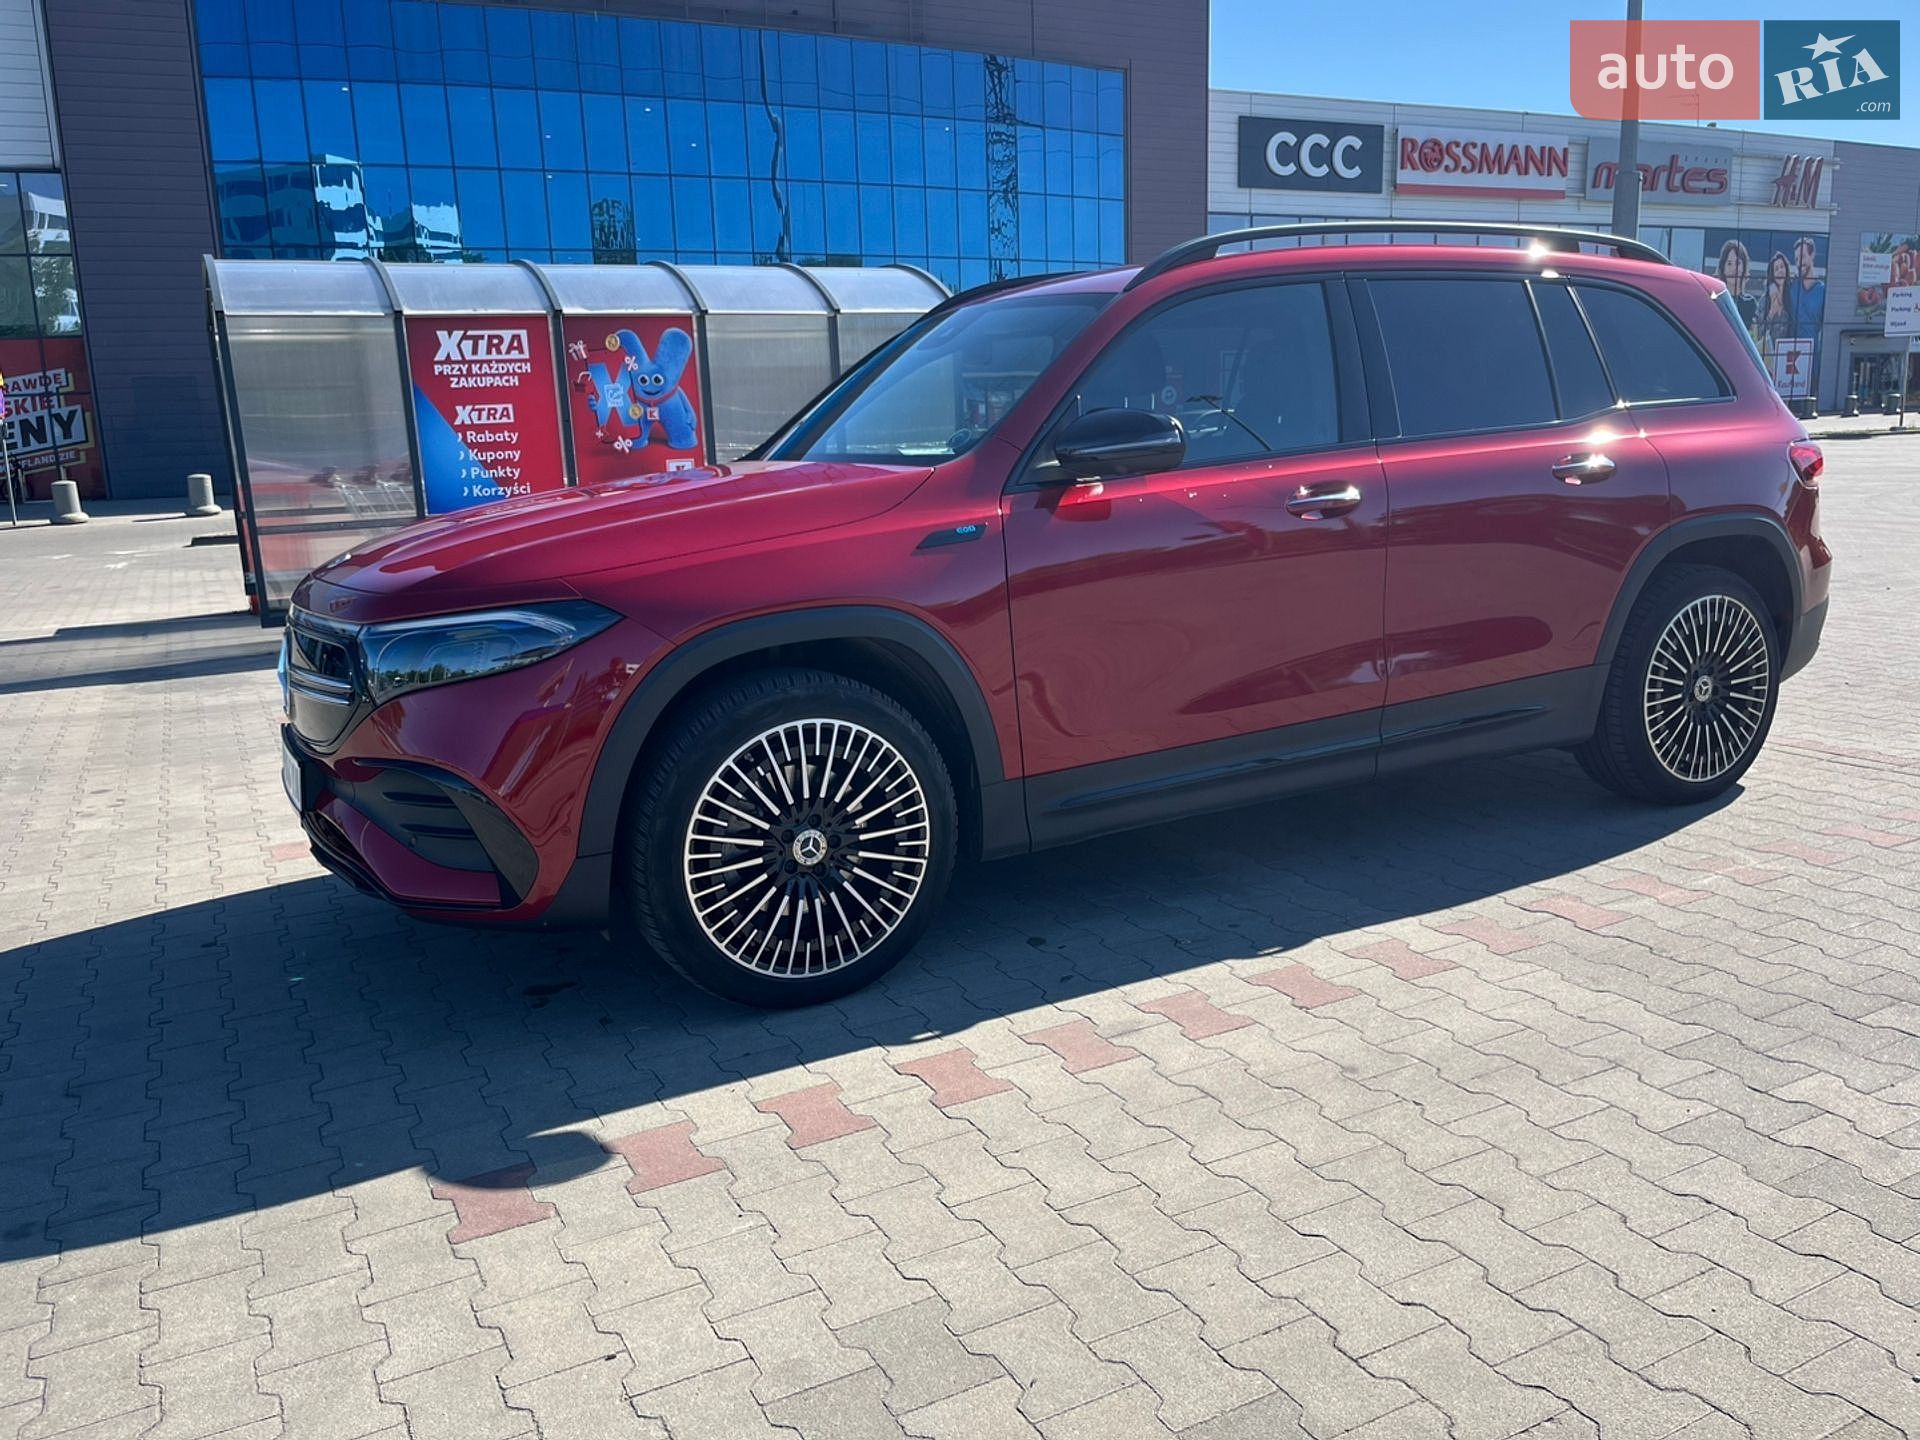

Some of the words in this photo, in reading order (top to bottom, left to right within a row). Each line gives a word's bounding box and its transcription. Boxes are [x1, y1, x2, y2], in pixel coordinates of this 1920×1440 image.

[1265, 131, 1363, 179] CCC
[1400, 137, 1569, 178] ROSSMANN
[1772, 153, 1824, 208] H&M
[433, 329, 530, 361] XTRA
[434, 364, 468, 375] PRZY
[471, 361, 531, 375] KAŻDYCH
[450, 376, 519, 388] ZAKUPACH
[454, 403, 514, 425] XTRA
[466, 430, 519, 444] Rabaty
[469, 448, 521, 463] Kupony
[470, 465, 521, 480] Punkty
[472, 482, 531, 498] Korzyści
